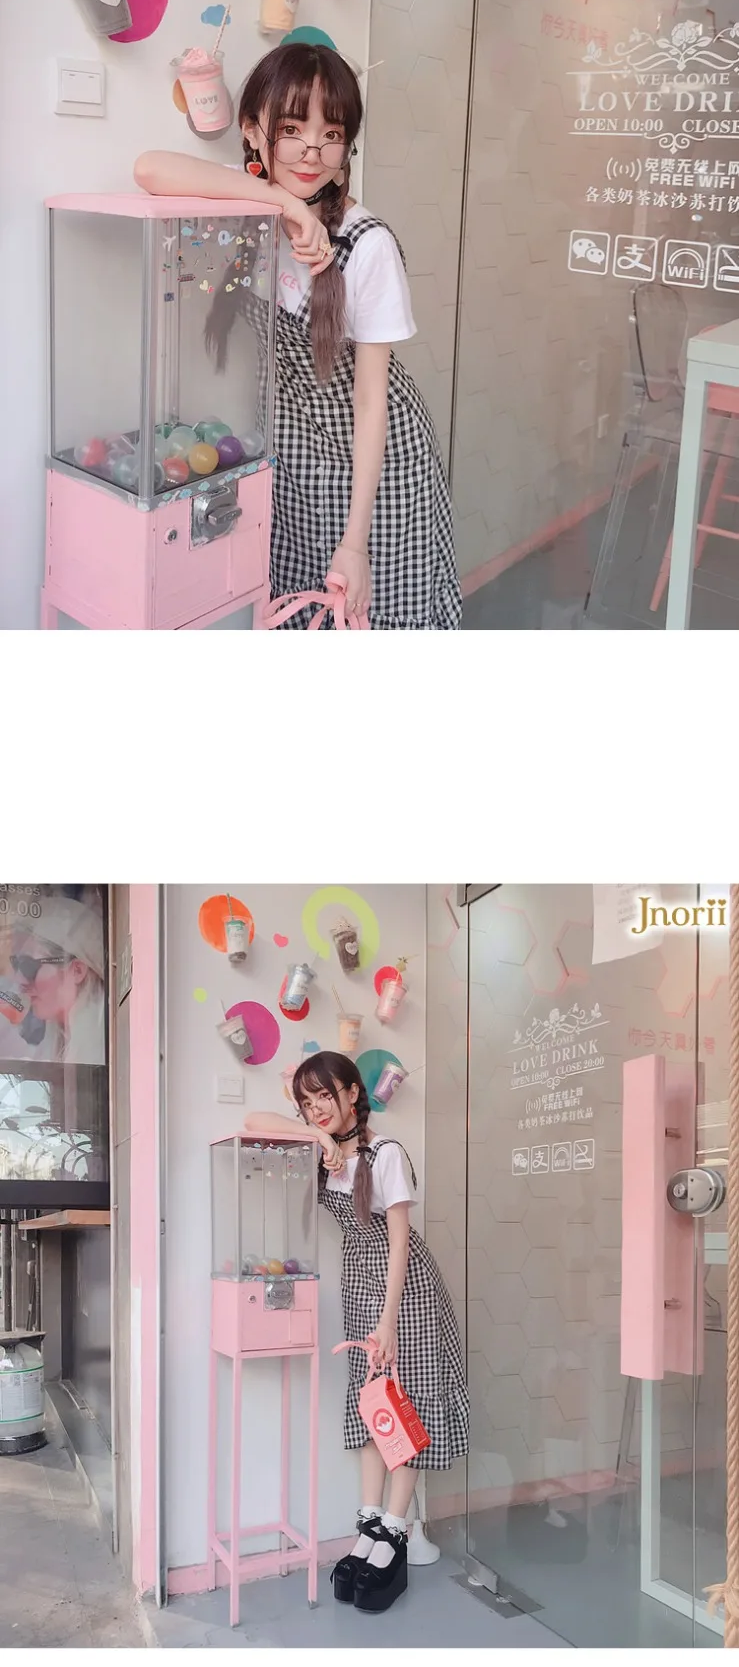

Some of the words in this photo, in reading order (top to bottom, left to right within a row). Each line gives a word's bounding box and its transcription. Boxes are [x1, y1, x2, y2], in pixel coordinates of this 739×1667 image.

[635, 72, 730, 86] WELCOME
[578, 91, 662, 112] LOVE
[673, 91, 739, 112] DRI
[574, 118, 618, 131] OPEN
[623, 119, 663, 131] 10:00
[681, 119, 739, 133] CLOSE
[650, 173, 694, 187] FREE
[698, 175, 736, 189] WiFi
[279, 271, 298, 290] ICE
[667, 265, 705, 281] WiFi
[535, 1034, 575, 1051] WELCOME
[513, 1053, 548, 1075] LOVE
[552, 1039, 598, 1064] DRINK
[556, 1061, 582, 1075] CLOSE
[544, 1100, 563, 1111] FREE
